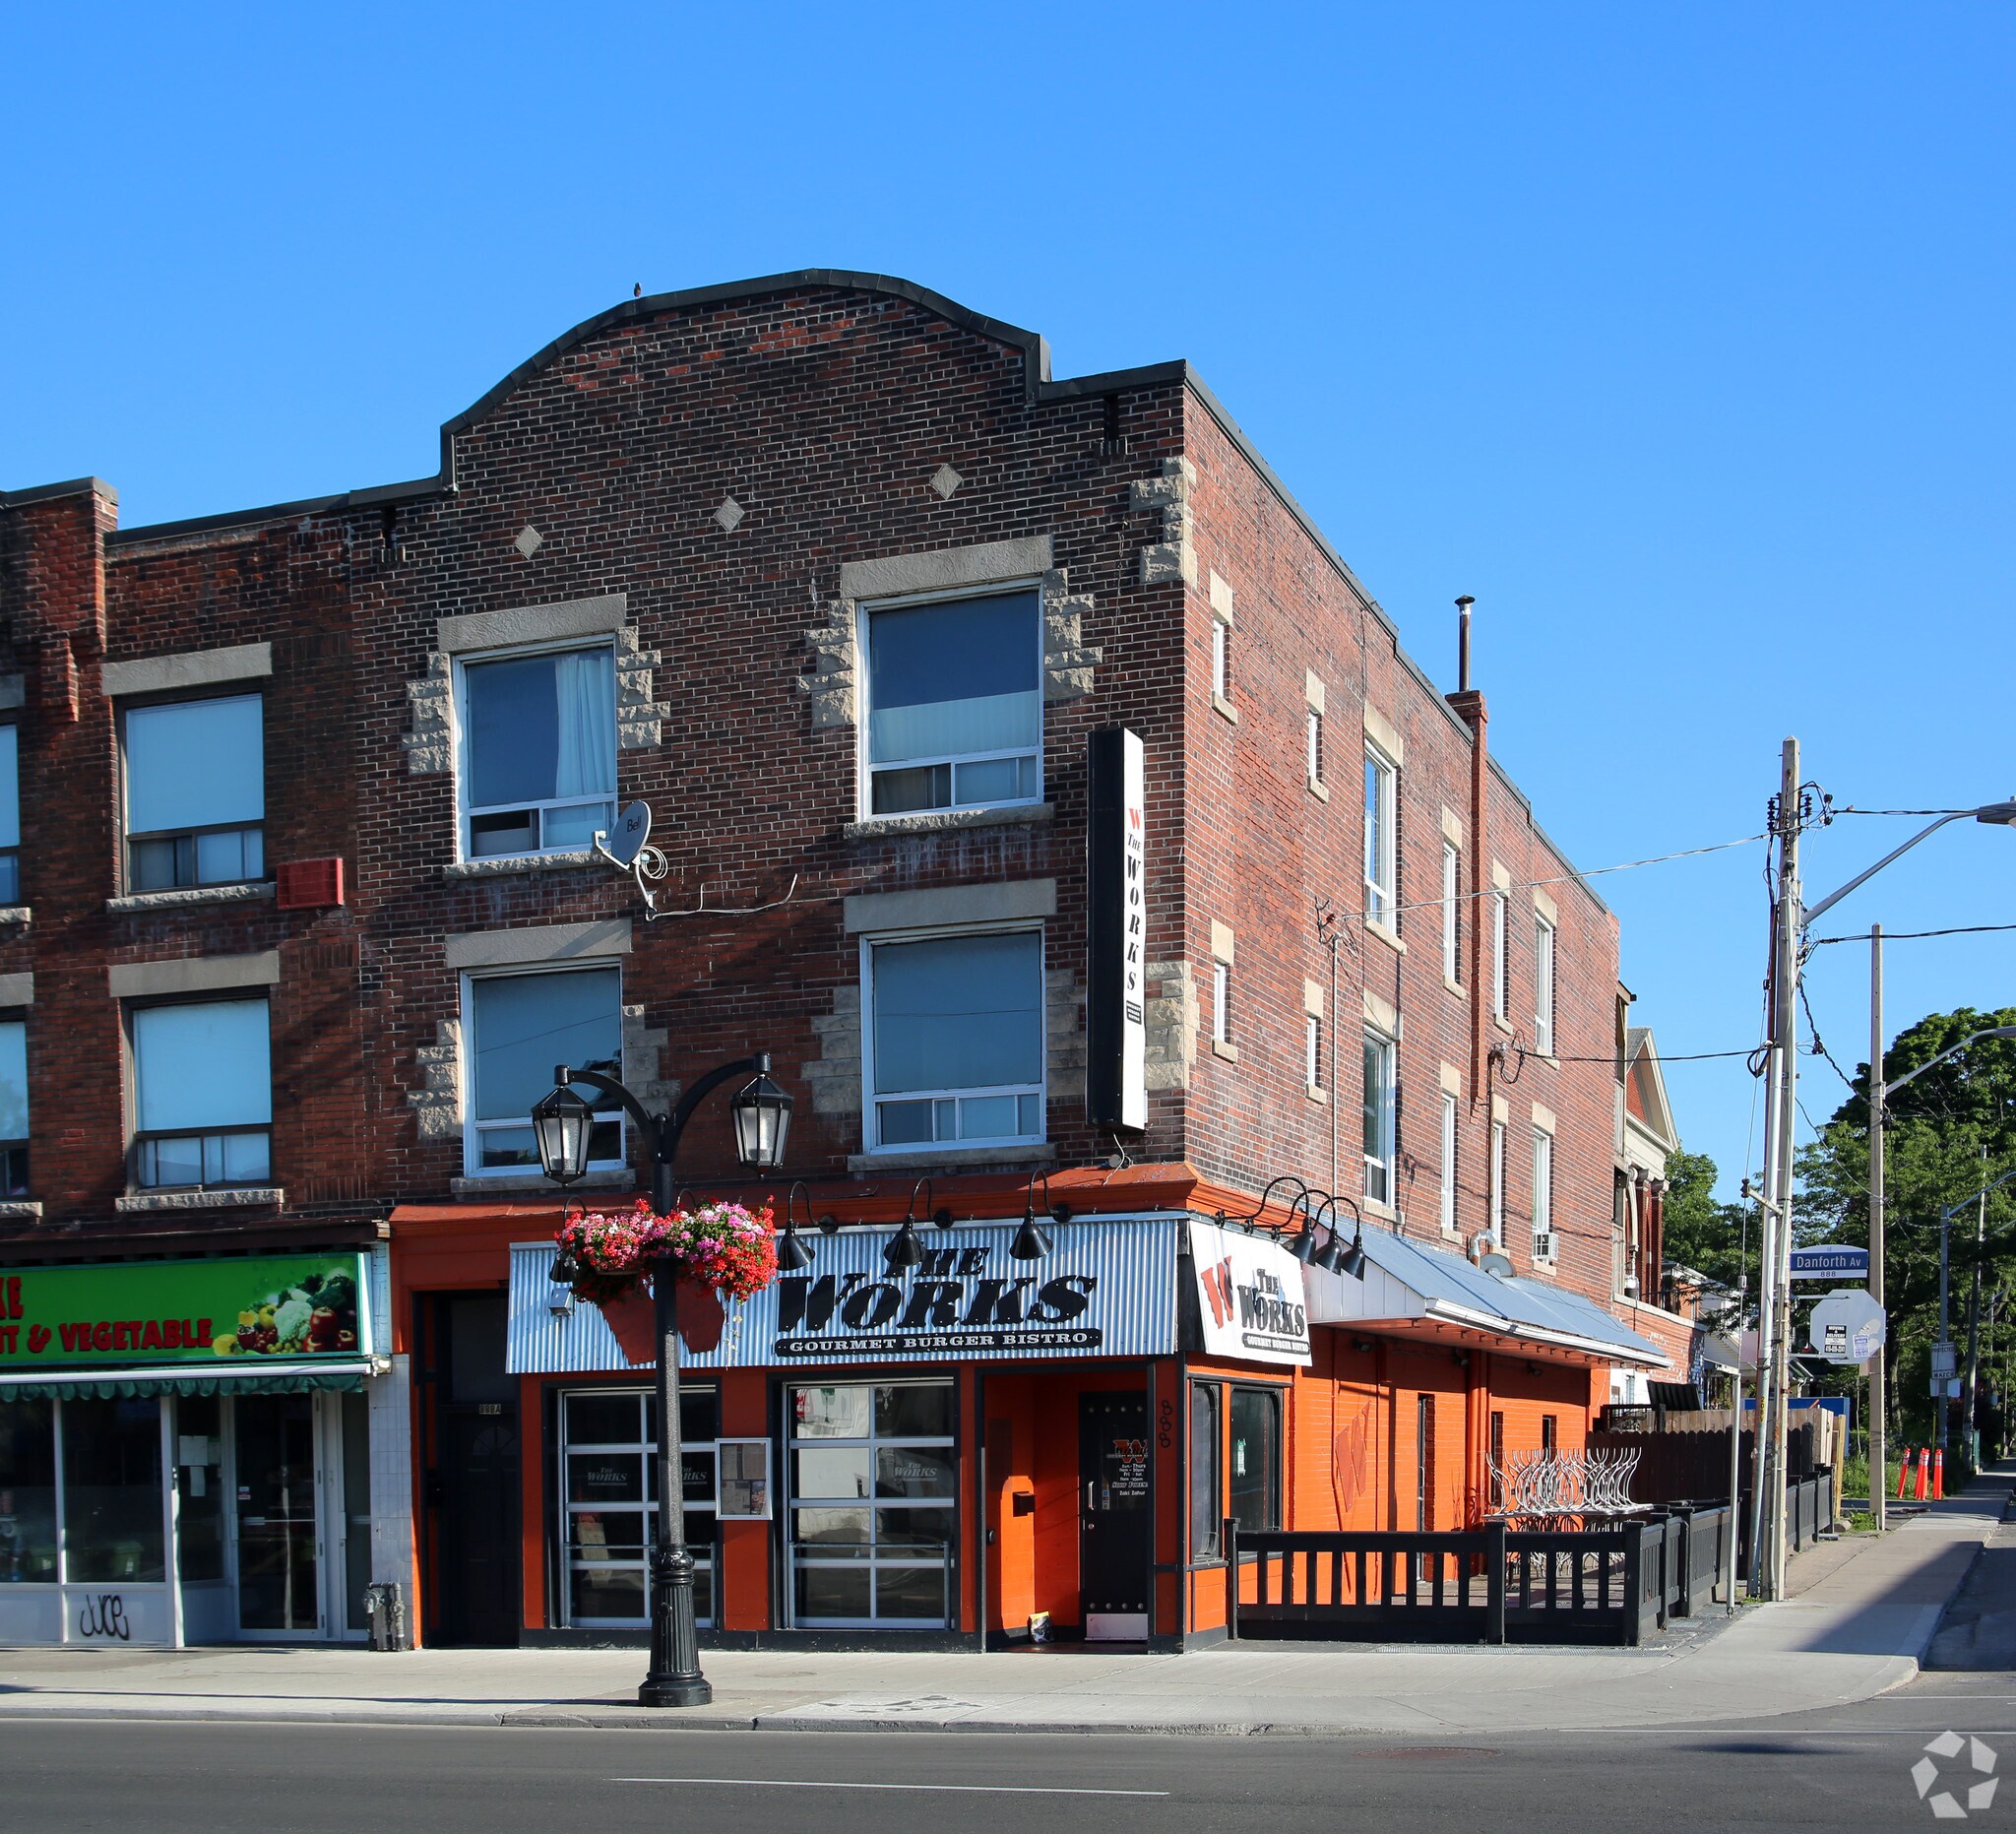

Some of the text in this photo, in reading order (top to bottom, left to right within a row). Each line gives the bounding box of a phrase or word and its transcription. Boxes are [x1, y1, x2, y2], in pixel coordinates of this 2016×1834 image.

[627, 816, 641, 832] Bell
[1128, 808, 1142, 830] W
[1127, 833, 1141, 852] THE
[1126, 854, 1142, 990] WORKS
[1796, 1256, 1861, 1268] Danforth Av
[1257, 1268, 1279, 1296] THE
[778, 1274, 1098, 1332] WORKS
[1237, 1285, 1305, 1337] WORKS
[28, 1323, 51, 1354] &
[59, 1318, 213, 1352] VEGETABLE
[789, 1332, 1089, 1352] GOURMET BURGER BISTRO
[588, 1472, 627, 1482] WORKS
[681, 1472, 708, 1481] RKS
[894, 1467, 937, 1477] WORKS
